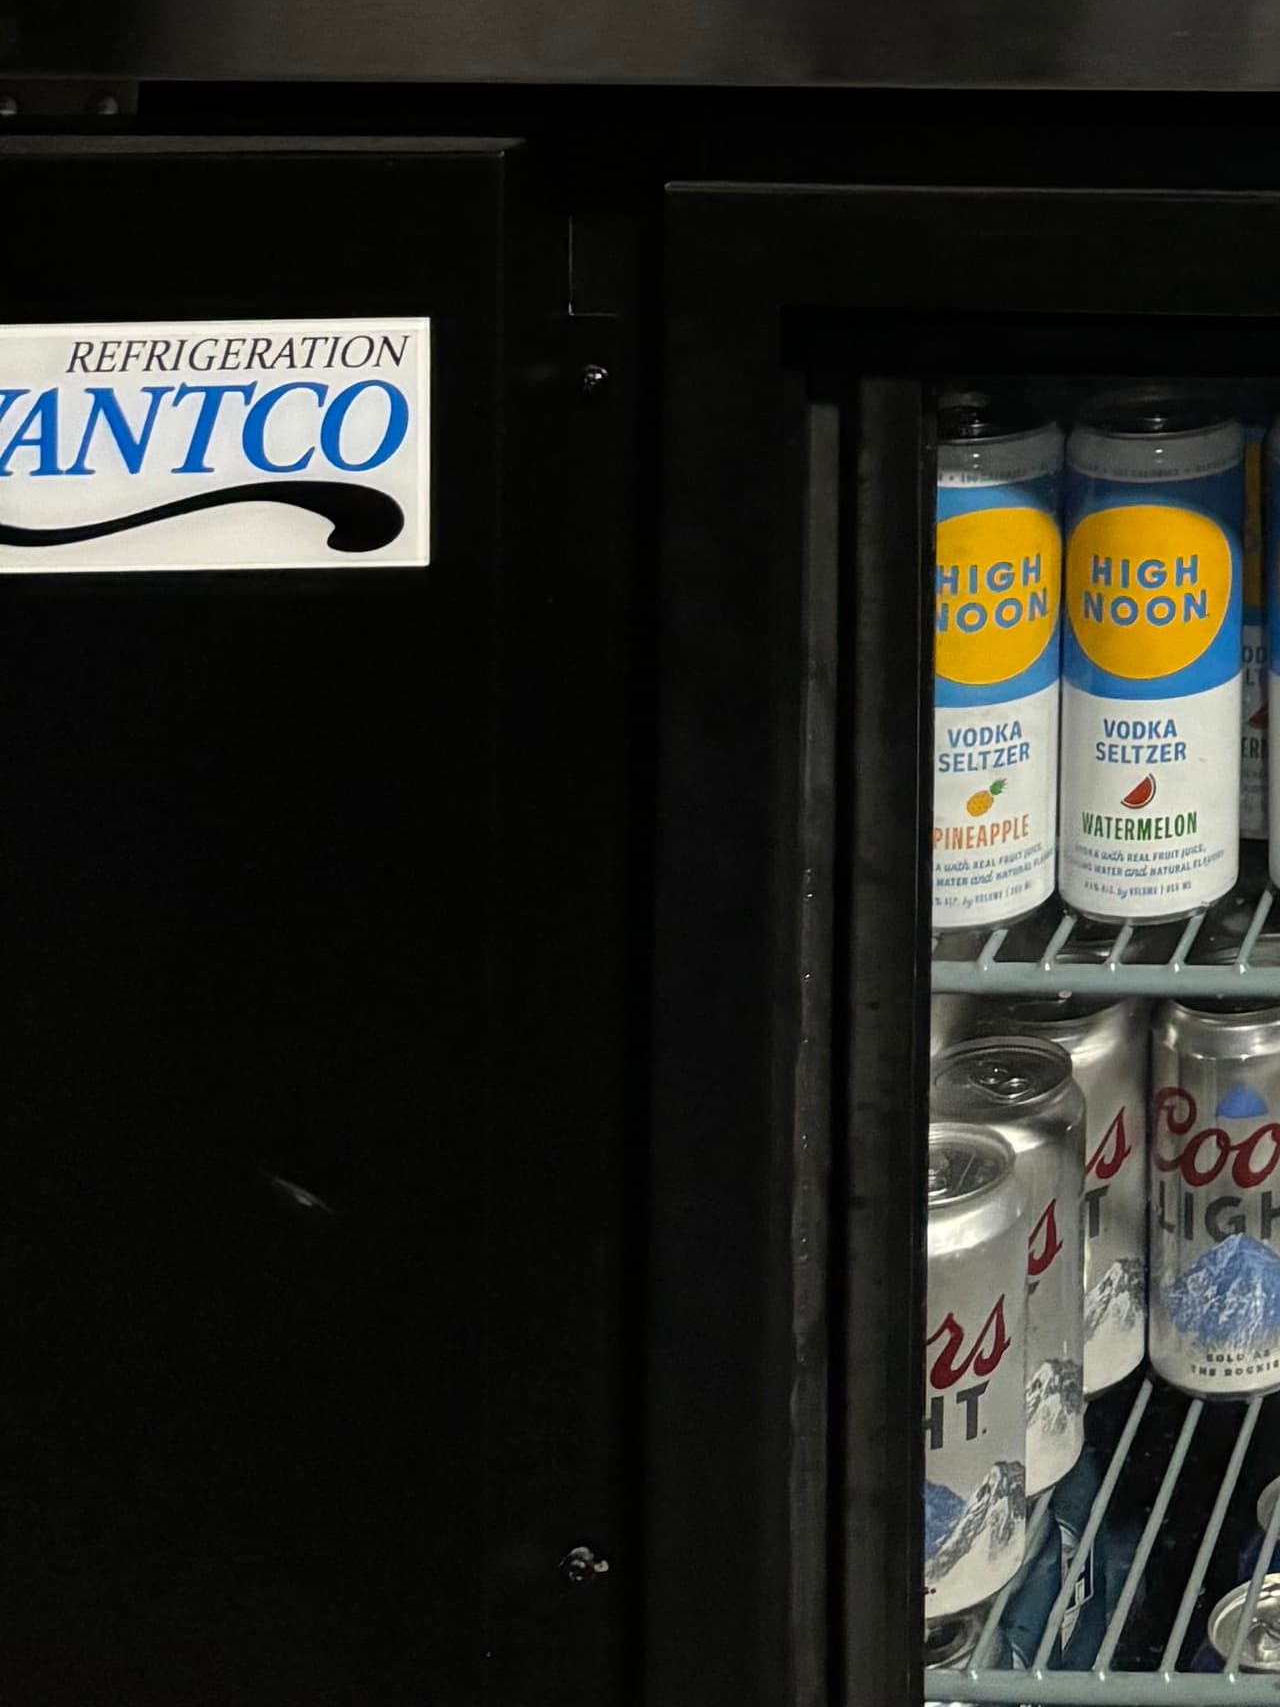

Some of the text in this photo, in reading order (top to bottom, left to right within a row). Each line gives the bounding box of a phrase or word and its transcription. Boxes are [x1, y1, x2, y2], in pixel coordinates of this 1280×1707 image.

[65, 334, 410, 374] REFRIGERATION
[936, 552, 1042, 597] HIGH
[1091, 554, 1199, 589] HIGH
[1083, 589, 1209, 626] NOON
[947, 720, 1023, 749] VODKA
[1103, 718, 1178, 740] VODKA
[938, 742, 1030, 774] SELTZER
[1095, 741, 1187, 765] SELTZER
[932, 814, 1030, 851] PINEAPPLE
[1081, 811, 1198, 841] WATERMELON
